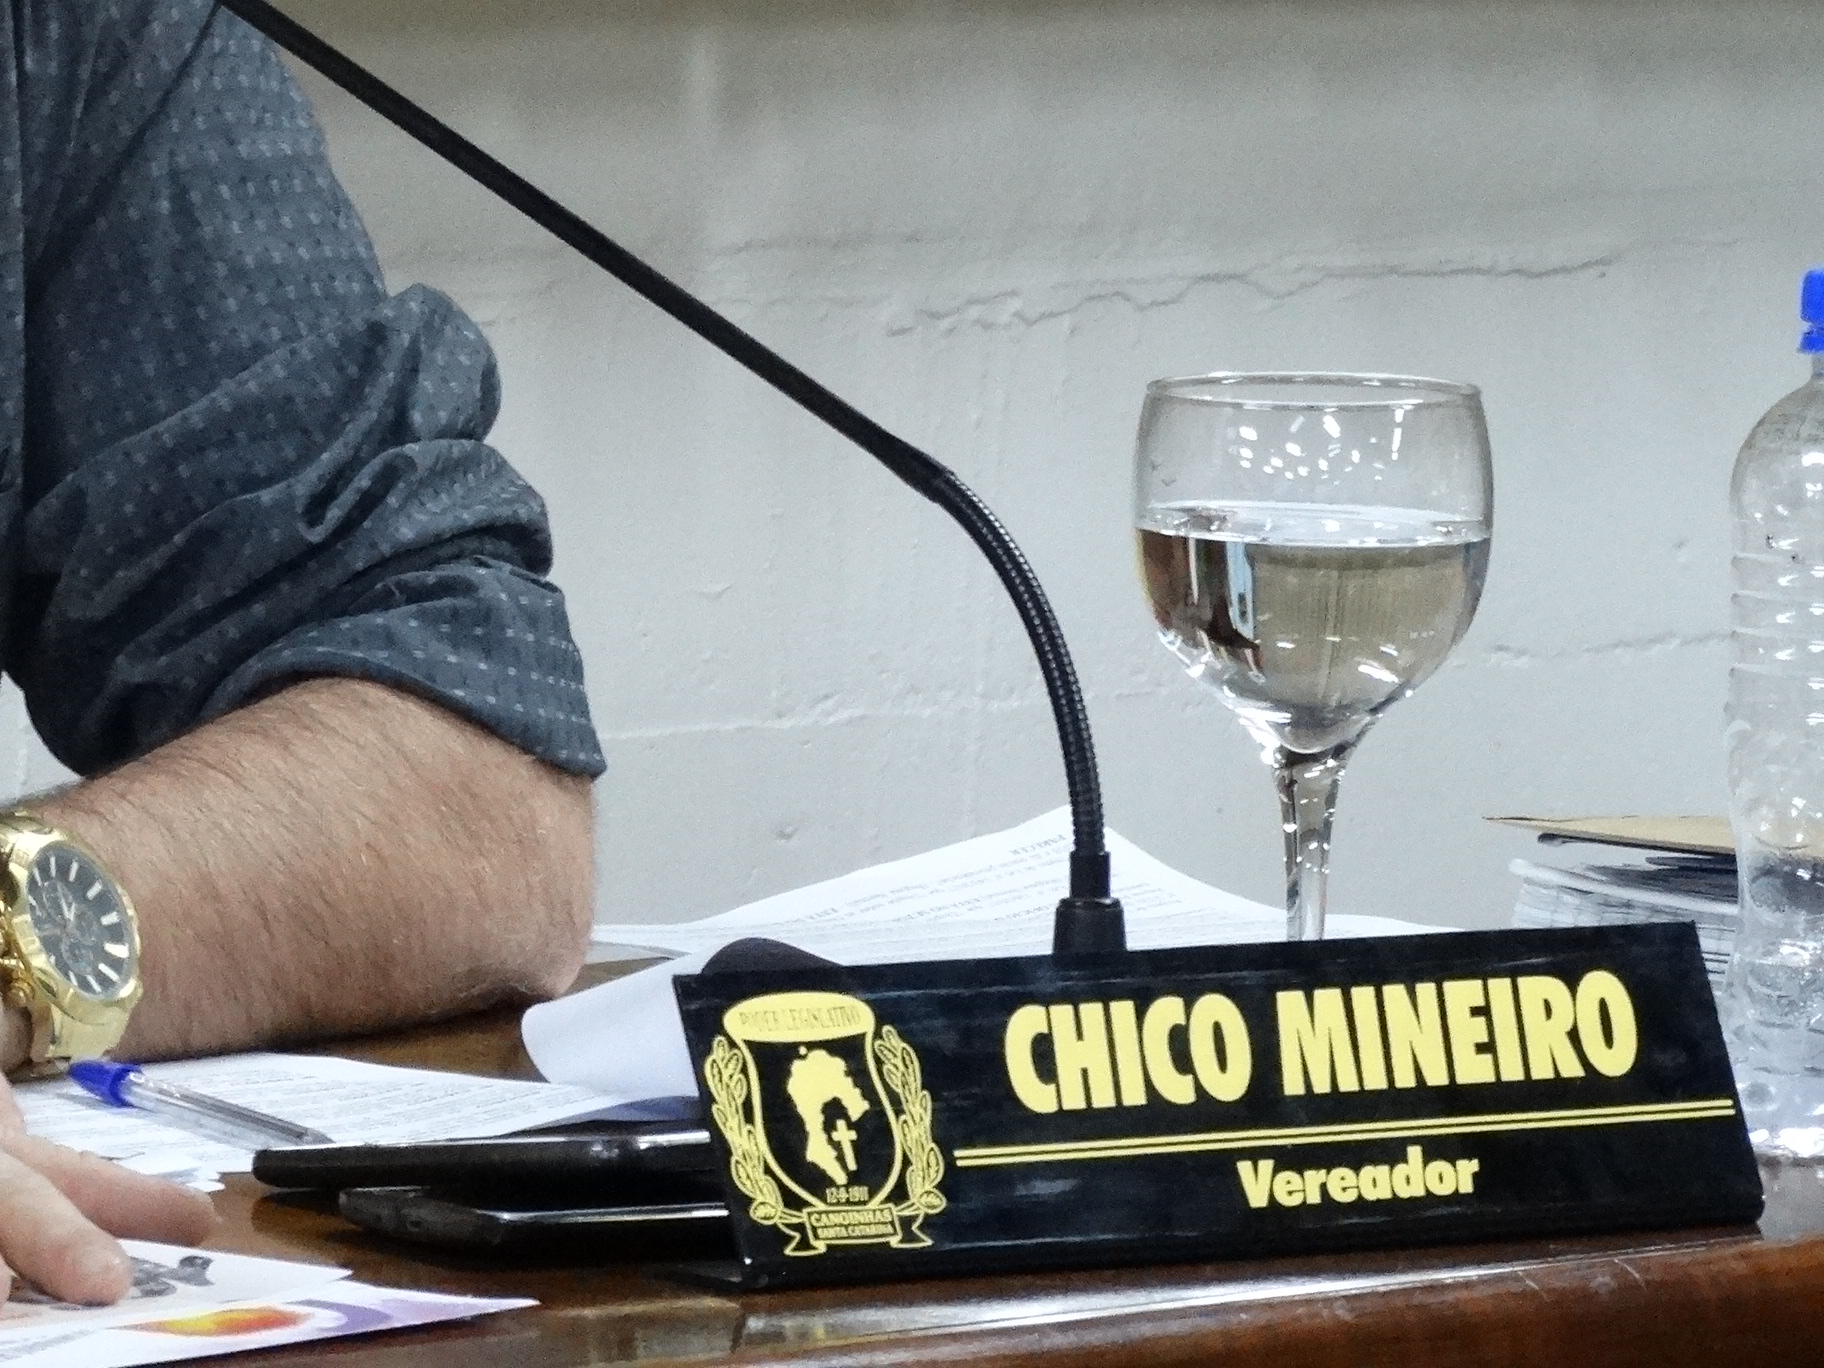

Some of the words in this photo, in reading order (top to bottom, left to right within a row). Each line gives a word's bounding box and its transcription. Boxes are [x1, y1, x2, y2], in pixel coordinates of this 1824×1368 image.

[1004, 993, 1253, 1114] CHICO
[1276, 970, 1639, 1097] MINEIRO
[1236, 1144, 1480, 1209] Vereador
[810, 1208, 893, 1227] CANOINHAS
